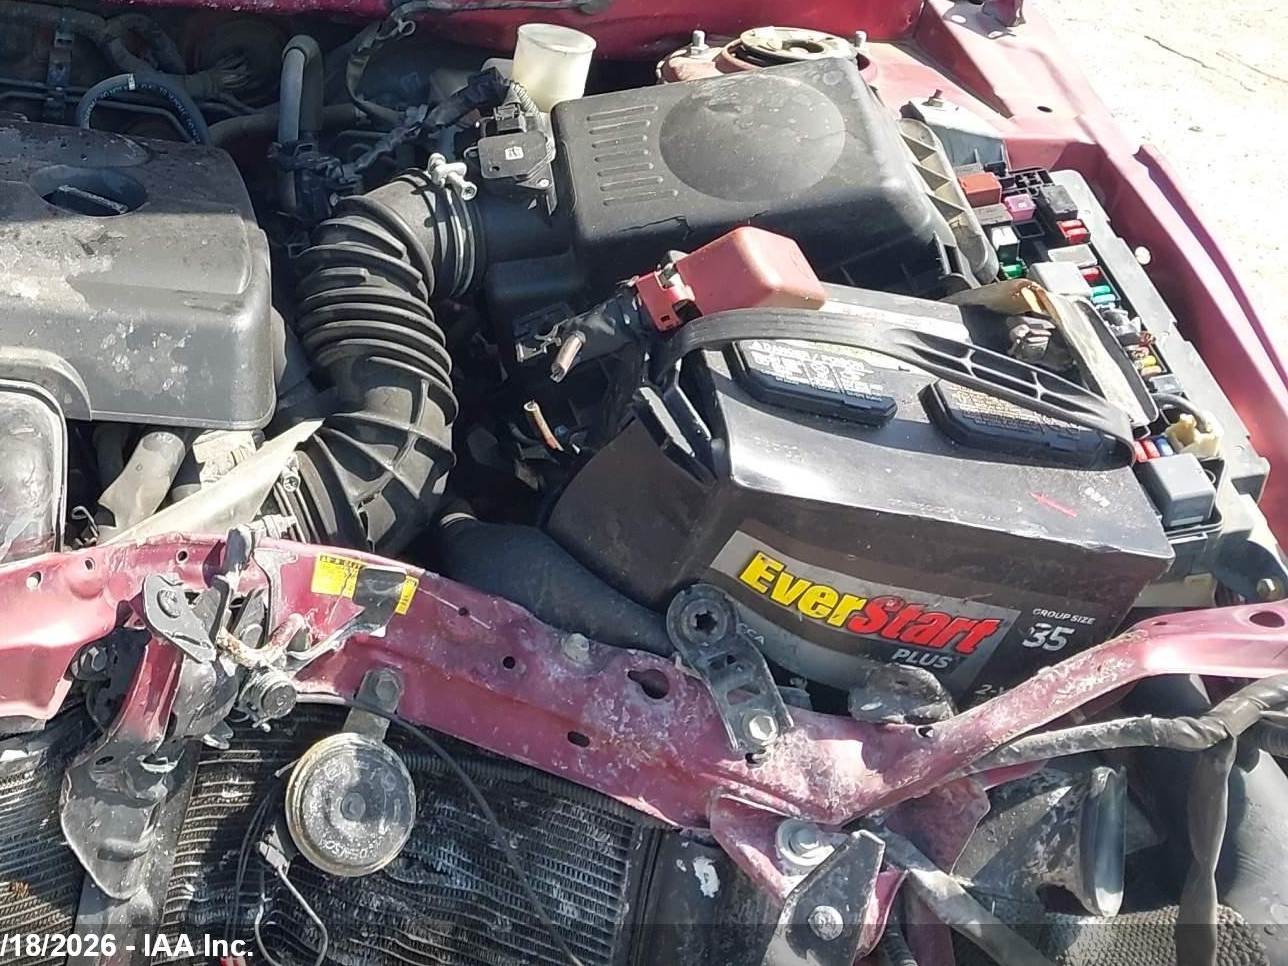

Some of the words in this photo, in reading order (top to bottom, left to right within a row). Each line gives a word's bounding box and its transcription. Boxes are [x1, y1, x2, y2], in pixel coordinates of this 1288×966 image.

[738, 550, 1003, 655] EverStart
[1032, 607, 1070, 623] GROUP
[1070, 613, 1096, 625] SIZE
[1022, 622, 1075, 652] 35
[892, 647, 953, 670] PLUS
